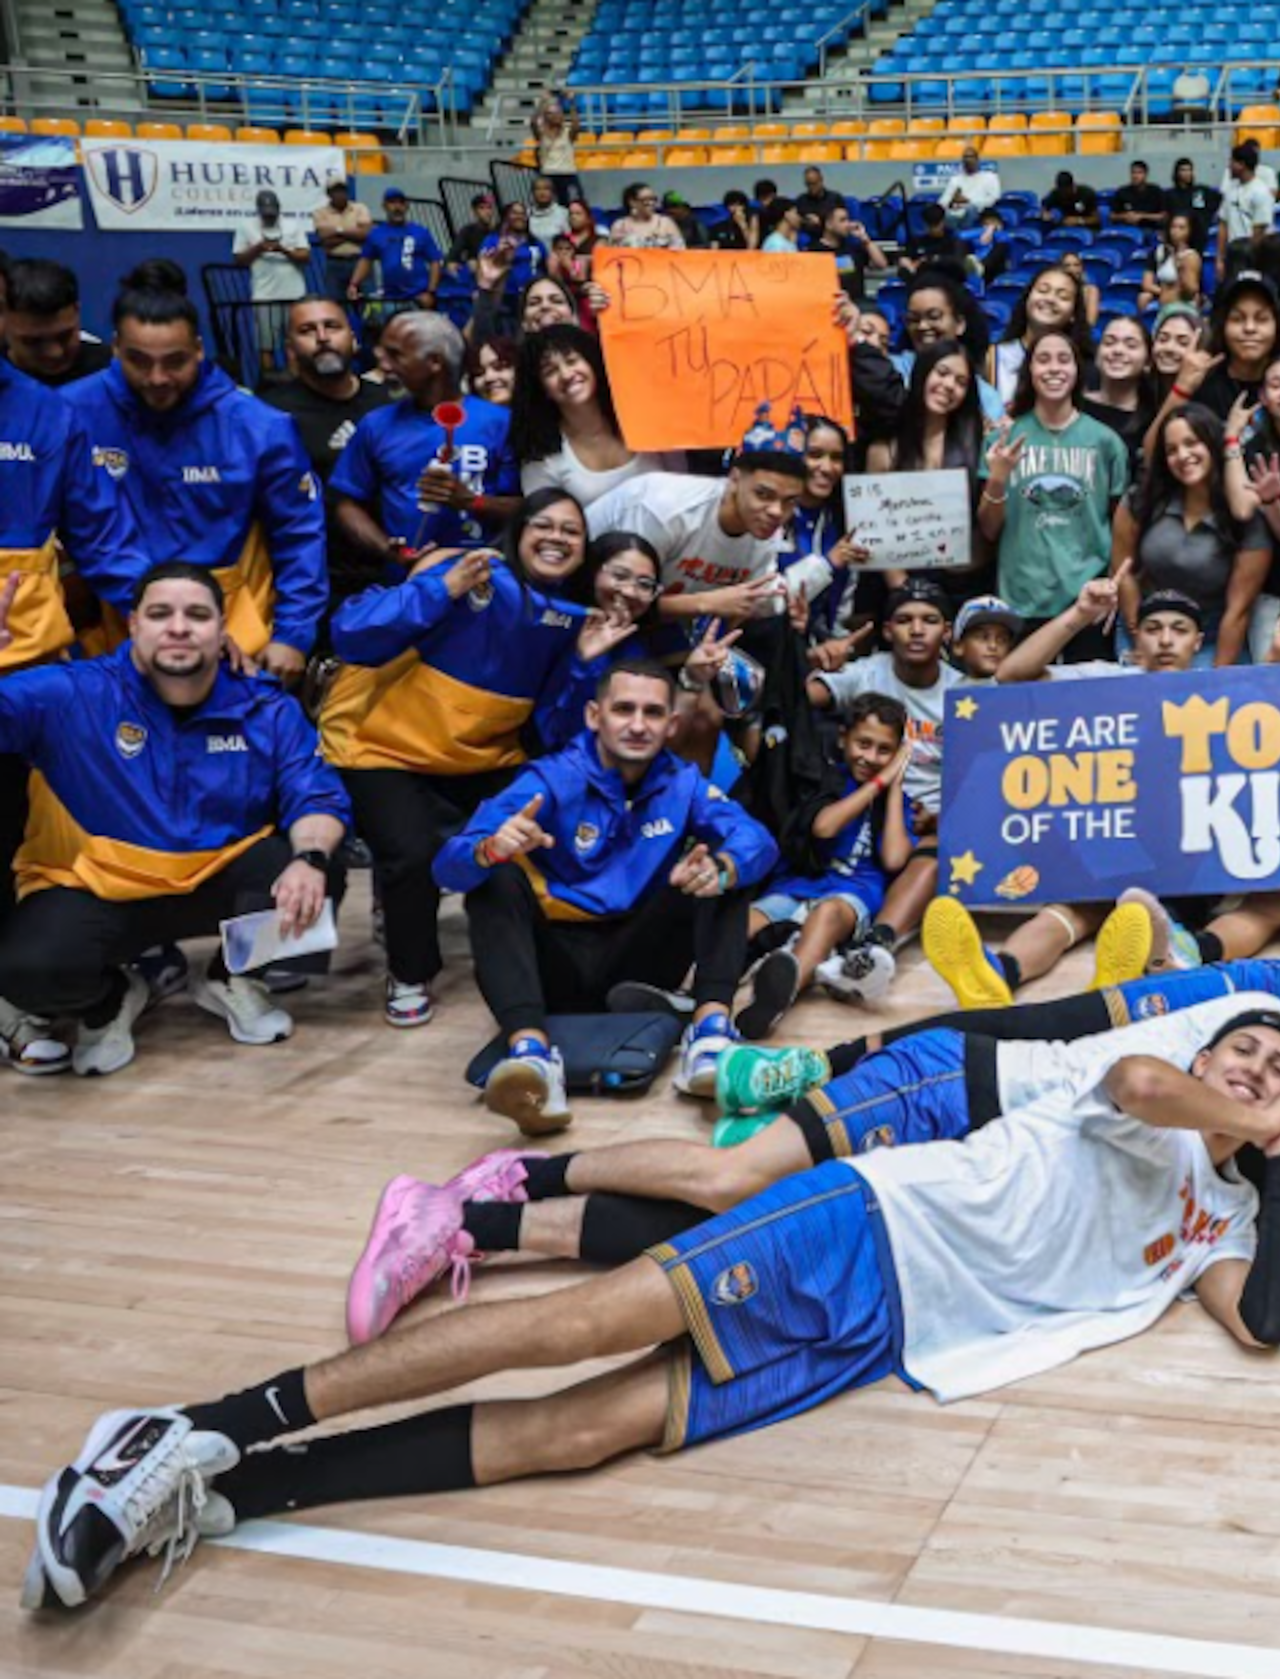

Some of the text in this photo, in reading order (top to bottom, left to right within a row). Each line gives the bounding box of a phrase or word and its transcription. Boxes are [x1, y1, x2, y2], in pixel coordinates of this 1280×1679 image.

[170, 187, 256, 205] COLLEG
[602, 255, 760, 323] BMA
[1000, 712, 1140, 753] WE ARE
[1002, 749, 1139, 811] ONE
[1001, 807, 1137, 845] OF THE
